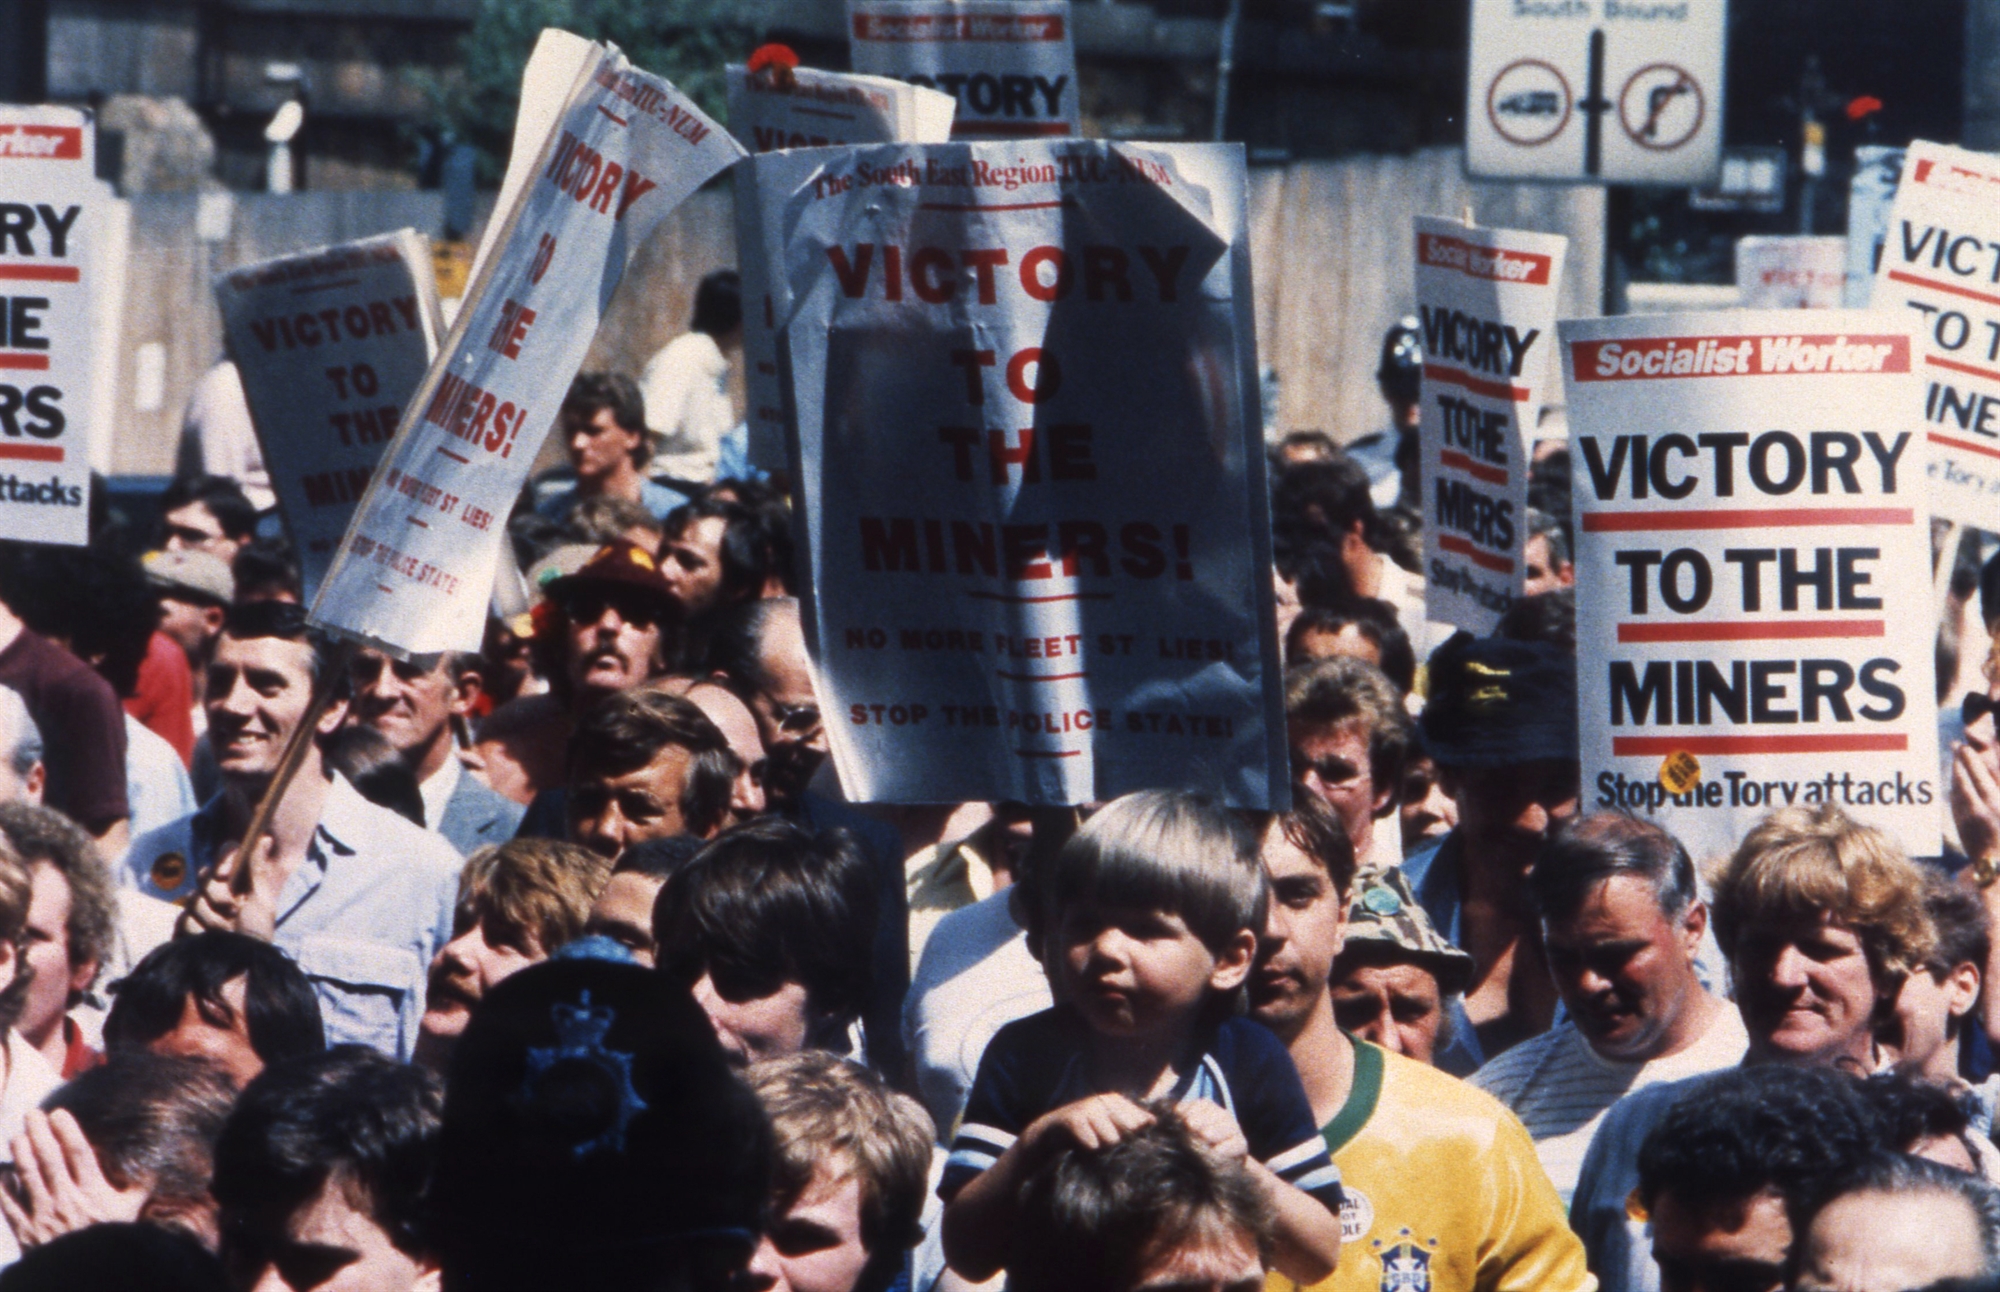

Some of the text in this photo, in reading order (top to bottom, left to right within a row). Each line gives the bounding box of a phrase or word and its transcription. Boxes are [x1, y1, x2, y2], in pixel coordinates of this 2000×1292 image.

[814, 154, 1173, 200] The South East Region TUC-NUM
[827, 243, 1191, 306] VICTORY
[0, 296, 50, 350] E
[251, 294, 418, 353] VICTORY
[325, 362, 379, 400] TO
[954, 346, 1062, 406] TO
[1595, 336, 1893, 377] Socialist Worker
[329, 405, 399, 446] THE
[1925, 381, 2000, 438] INE
[938, 424, 1098, 486] THE
[1579, 430, 1913, 500] VICTORY
[860, 517, 1194, 581] MINERS!
[1614, 547, 1884, 615] TO THE
[845, 628, 1234, 662] NO MORE FLEET ST LIES!
[1609, 657, 1907, 726] MINERS
[850, 703, 1234, 739] STOP THE POLICE STATE!
[1596, 769, 1666, 815] Stop
[1804, 770, 1934, 806] attacks
